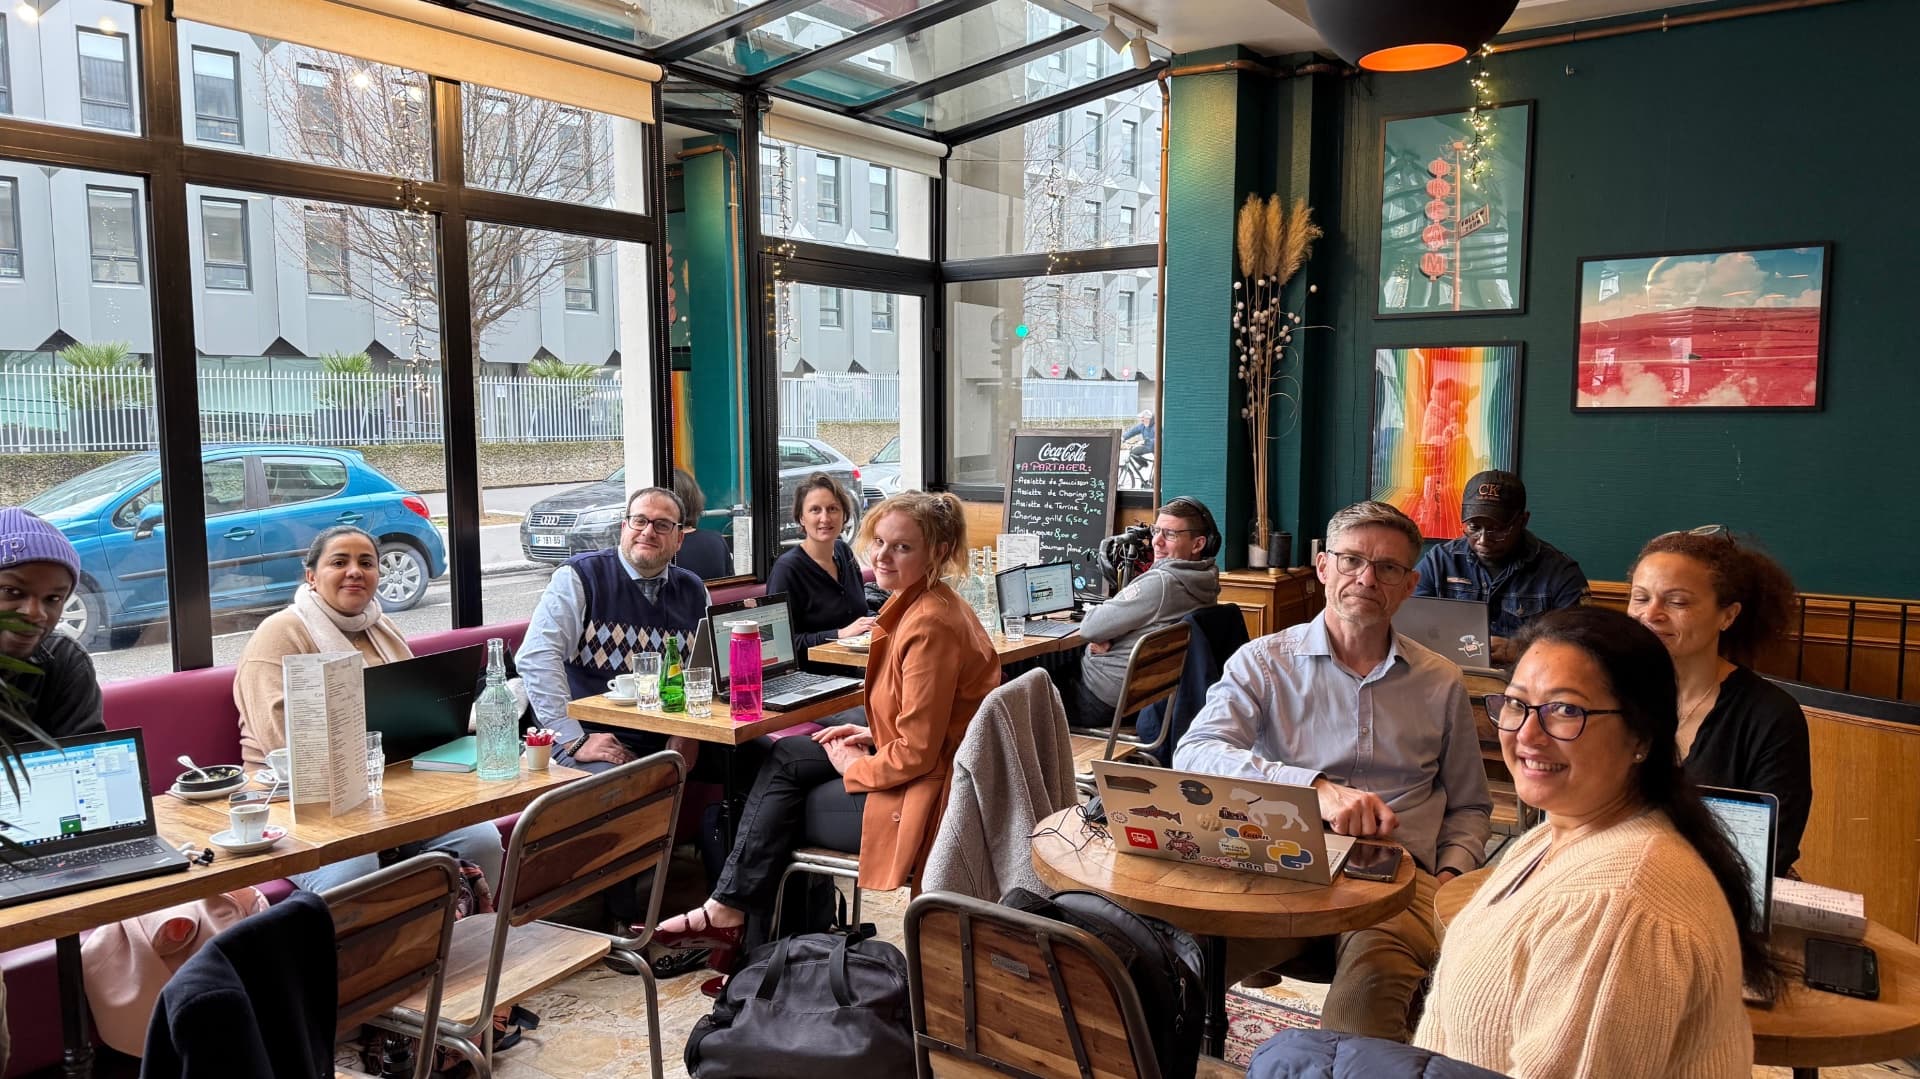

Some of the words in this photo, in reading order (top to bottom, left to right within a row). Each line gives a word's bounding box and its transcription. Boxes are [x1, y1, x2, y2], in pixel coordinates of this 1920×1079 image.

[1038, 442, 1090, 462] Coca-Cola
[1048, 489, 1056, 497] de
[1479, 483, 1500, 497] CK
[1054, 502, 1079, 511] Terrine
[1, 537, 26, 565] P
[1040, 541, 1065, 551] Saumon
